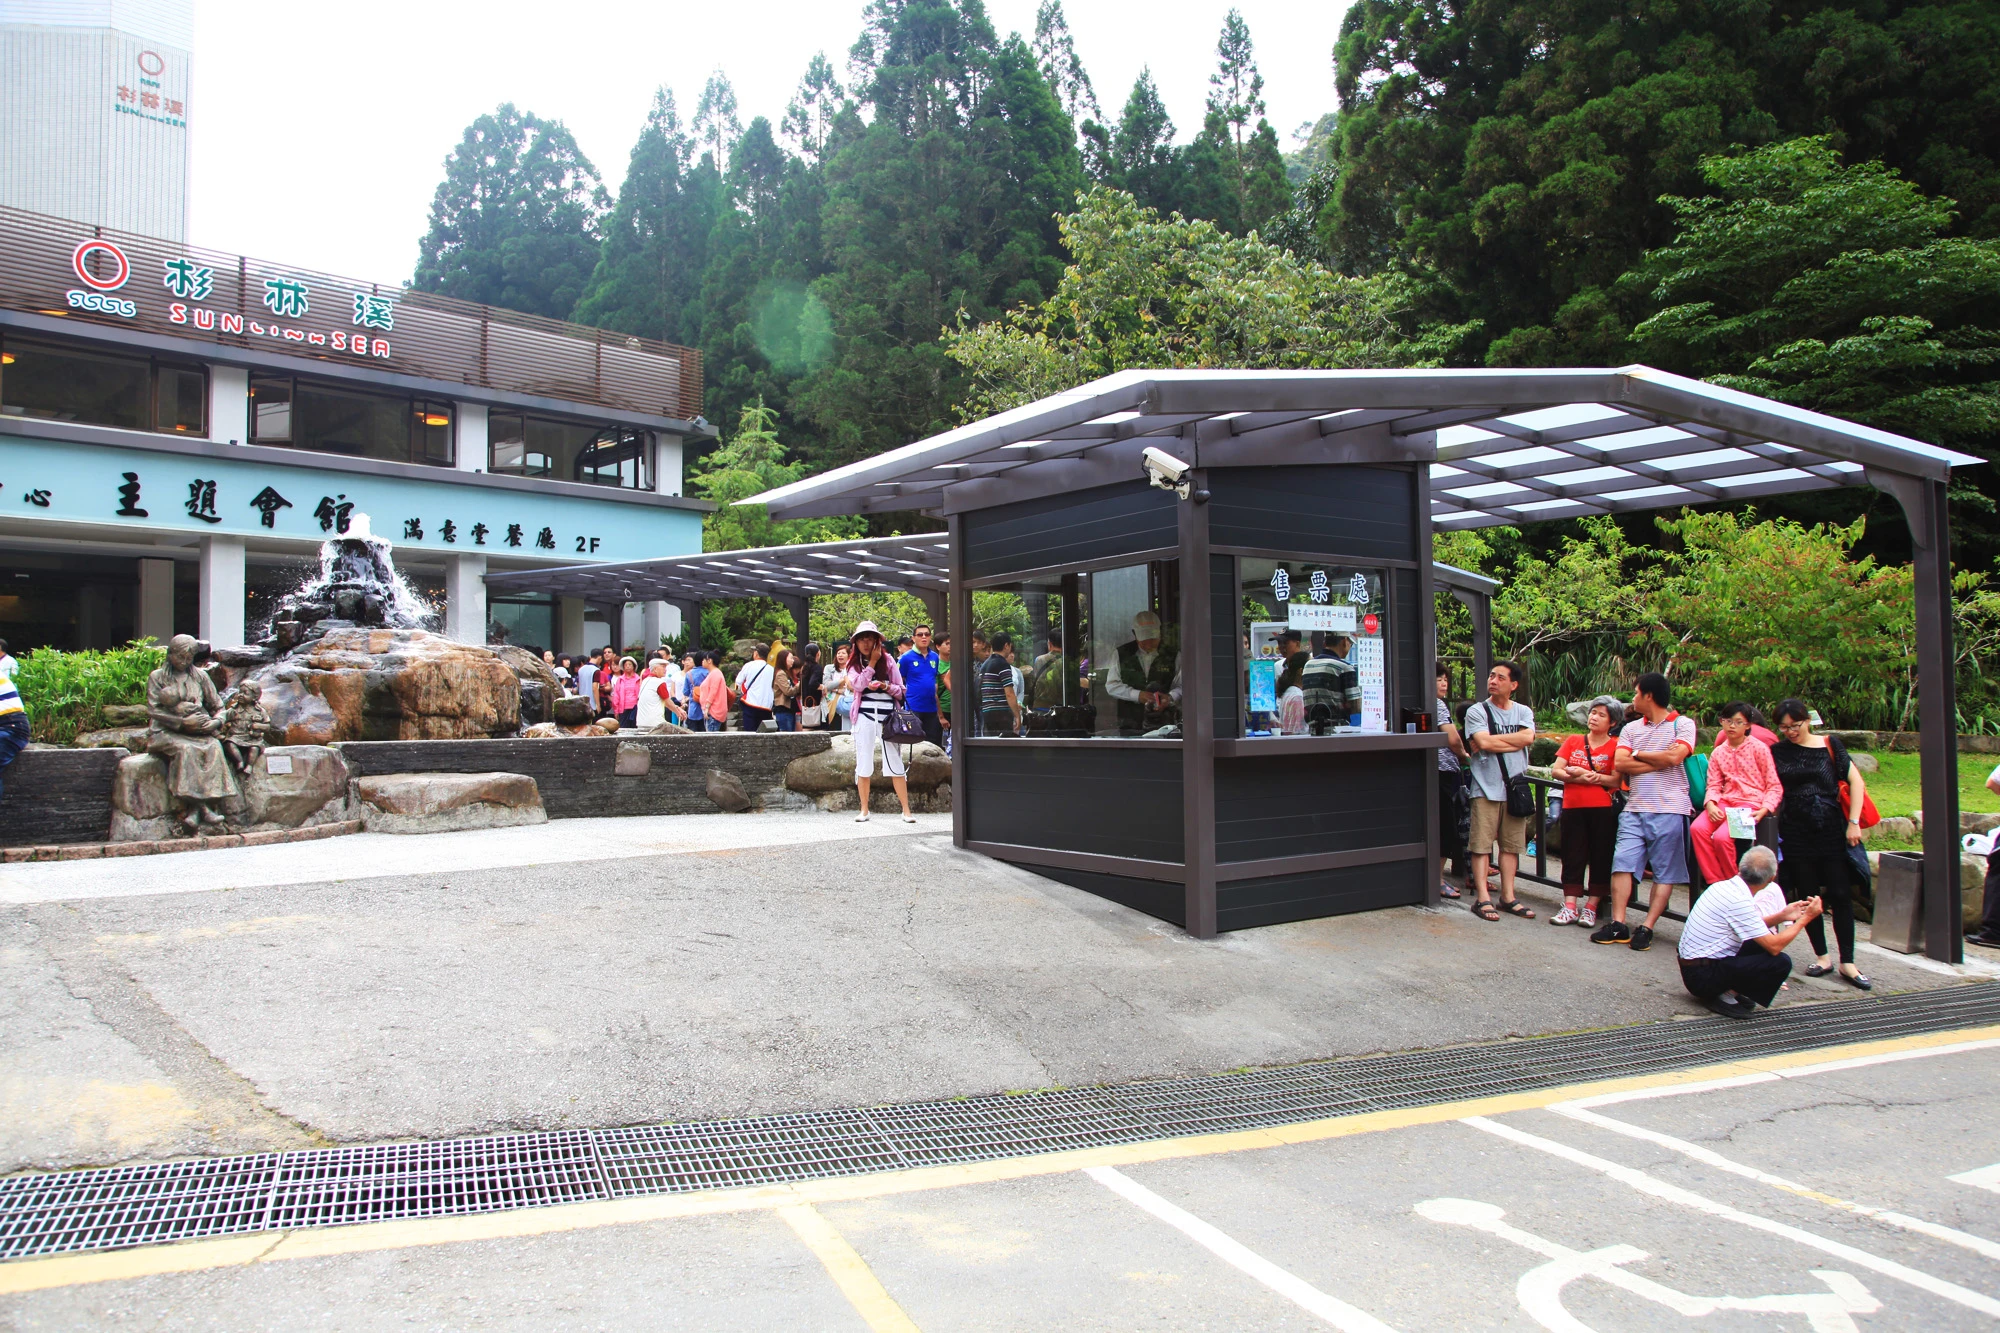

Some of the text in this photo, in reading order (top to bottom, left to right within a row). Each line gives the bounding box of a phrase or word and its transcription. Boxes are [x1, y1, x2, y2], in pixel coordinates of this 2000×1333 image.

[116, 85, 184, 116] 杉林溪
[165, 259, 394, 330] 杉林溪
[575, 535, 601, 553] 2F
[1270, 568, 1369, 604] 售票處
